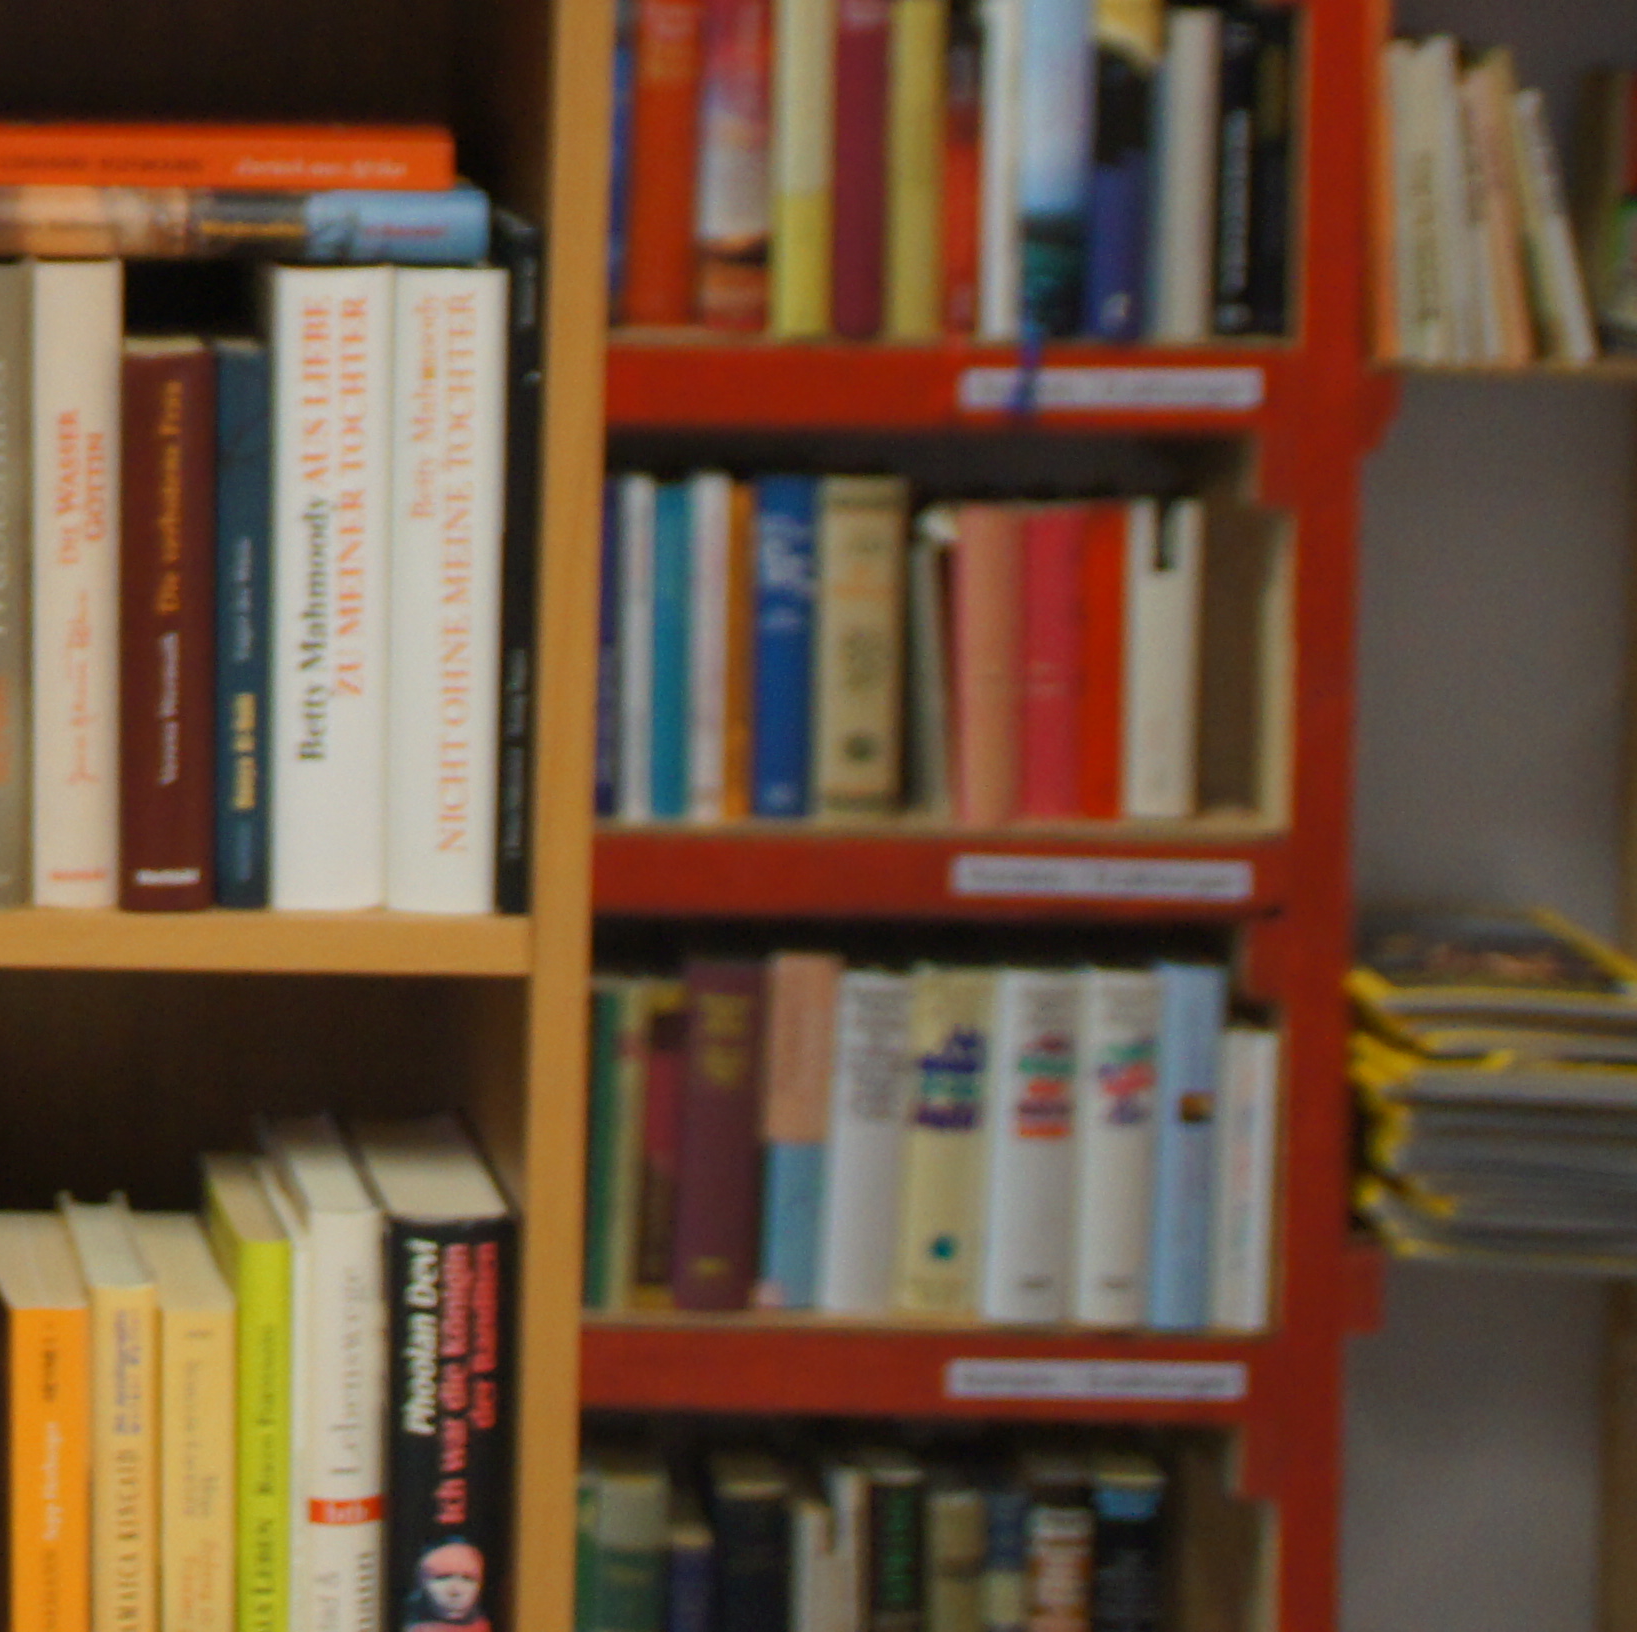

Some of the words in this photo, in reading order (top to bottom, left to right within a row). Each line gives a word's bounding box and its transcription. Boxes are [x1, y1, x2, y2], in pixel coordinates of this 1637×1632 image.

[299, 295, 331, 410] LIEBE
[333, 297, 368, 474] TOCHTER
[409, 291, 442, 444] Mahmoody
[440, 287, 478, 475] TOCHTER
[82, 431, 109, 543] GÖTTIN
[300, 415, 331, 487] AUS
[409, 457, 441, 520] Betty
[296, 498, 338, 673] Mahmoody
[334, 489, 368, 637] MEINER
[439, 490, 475, 607] MEINE
[296, 684, 337, 763] Betty
[335, 651, 366, 697] ZU
[438, 613, 474, 731] OHNE
[436, 739, 473, 855] NICHT
[406, 1238, 439, 1308] Devi
[402, 1311, 439, 1435] Phoolan
[438, 1363, 468, 1412] die
[432, 1479, 468, 1525] Ich
[439, 1418, 469, 1473] war
